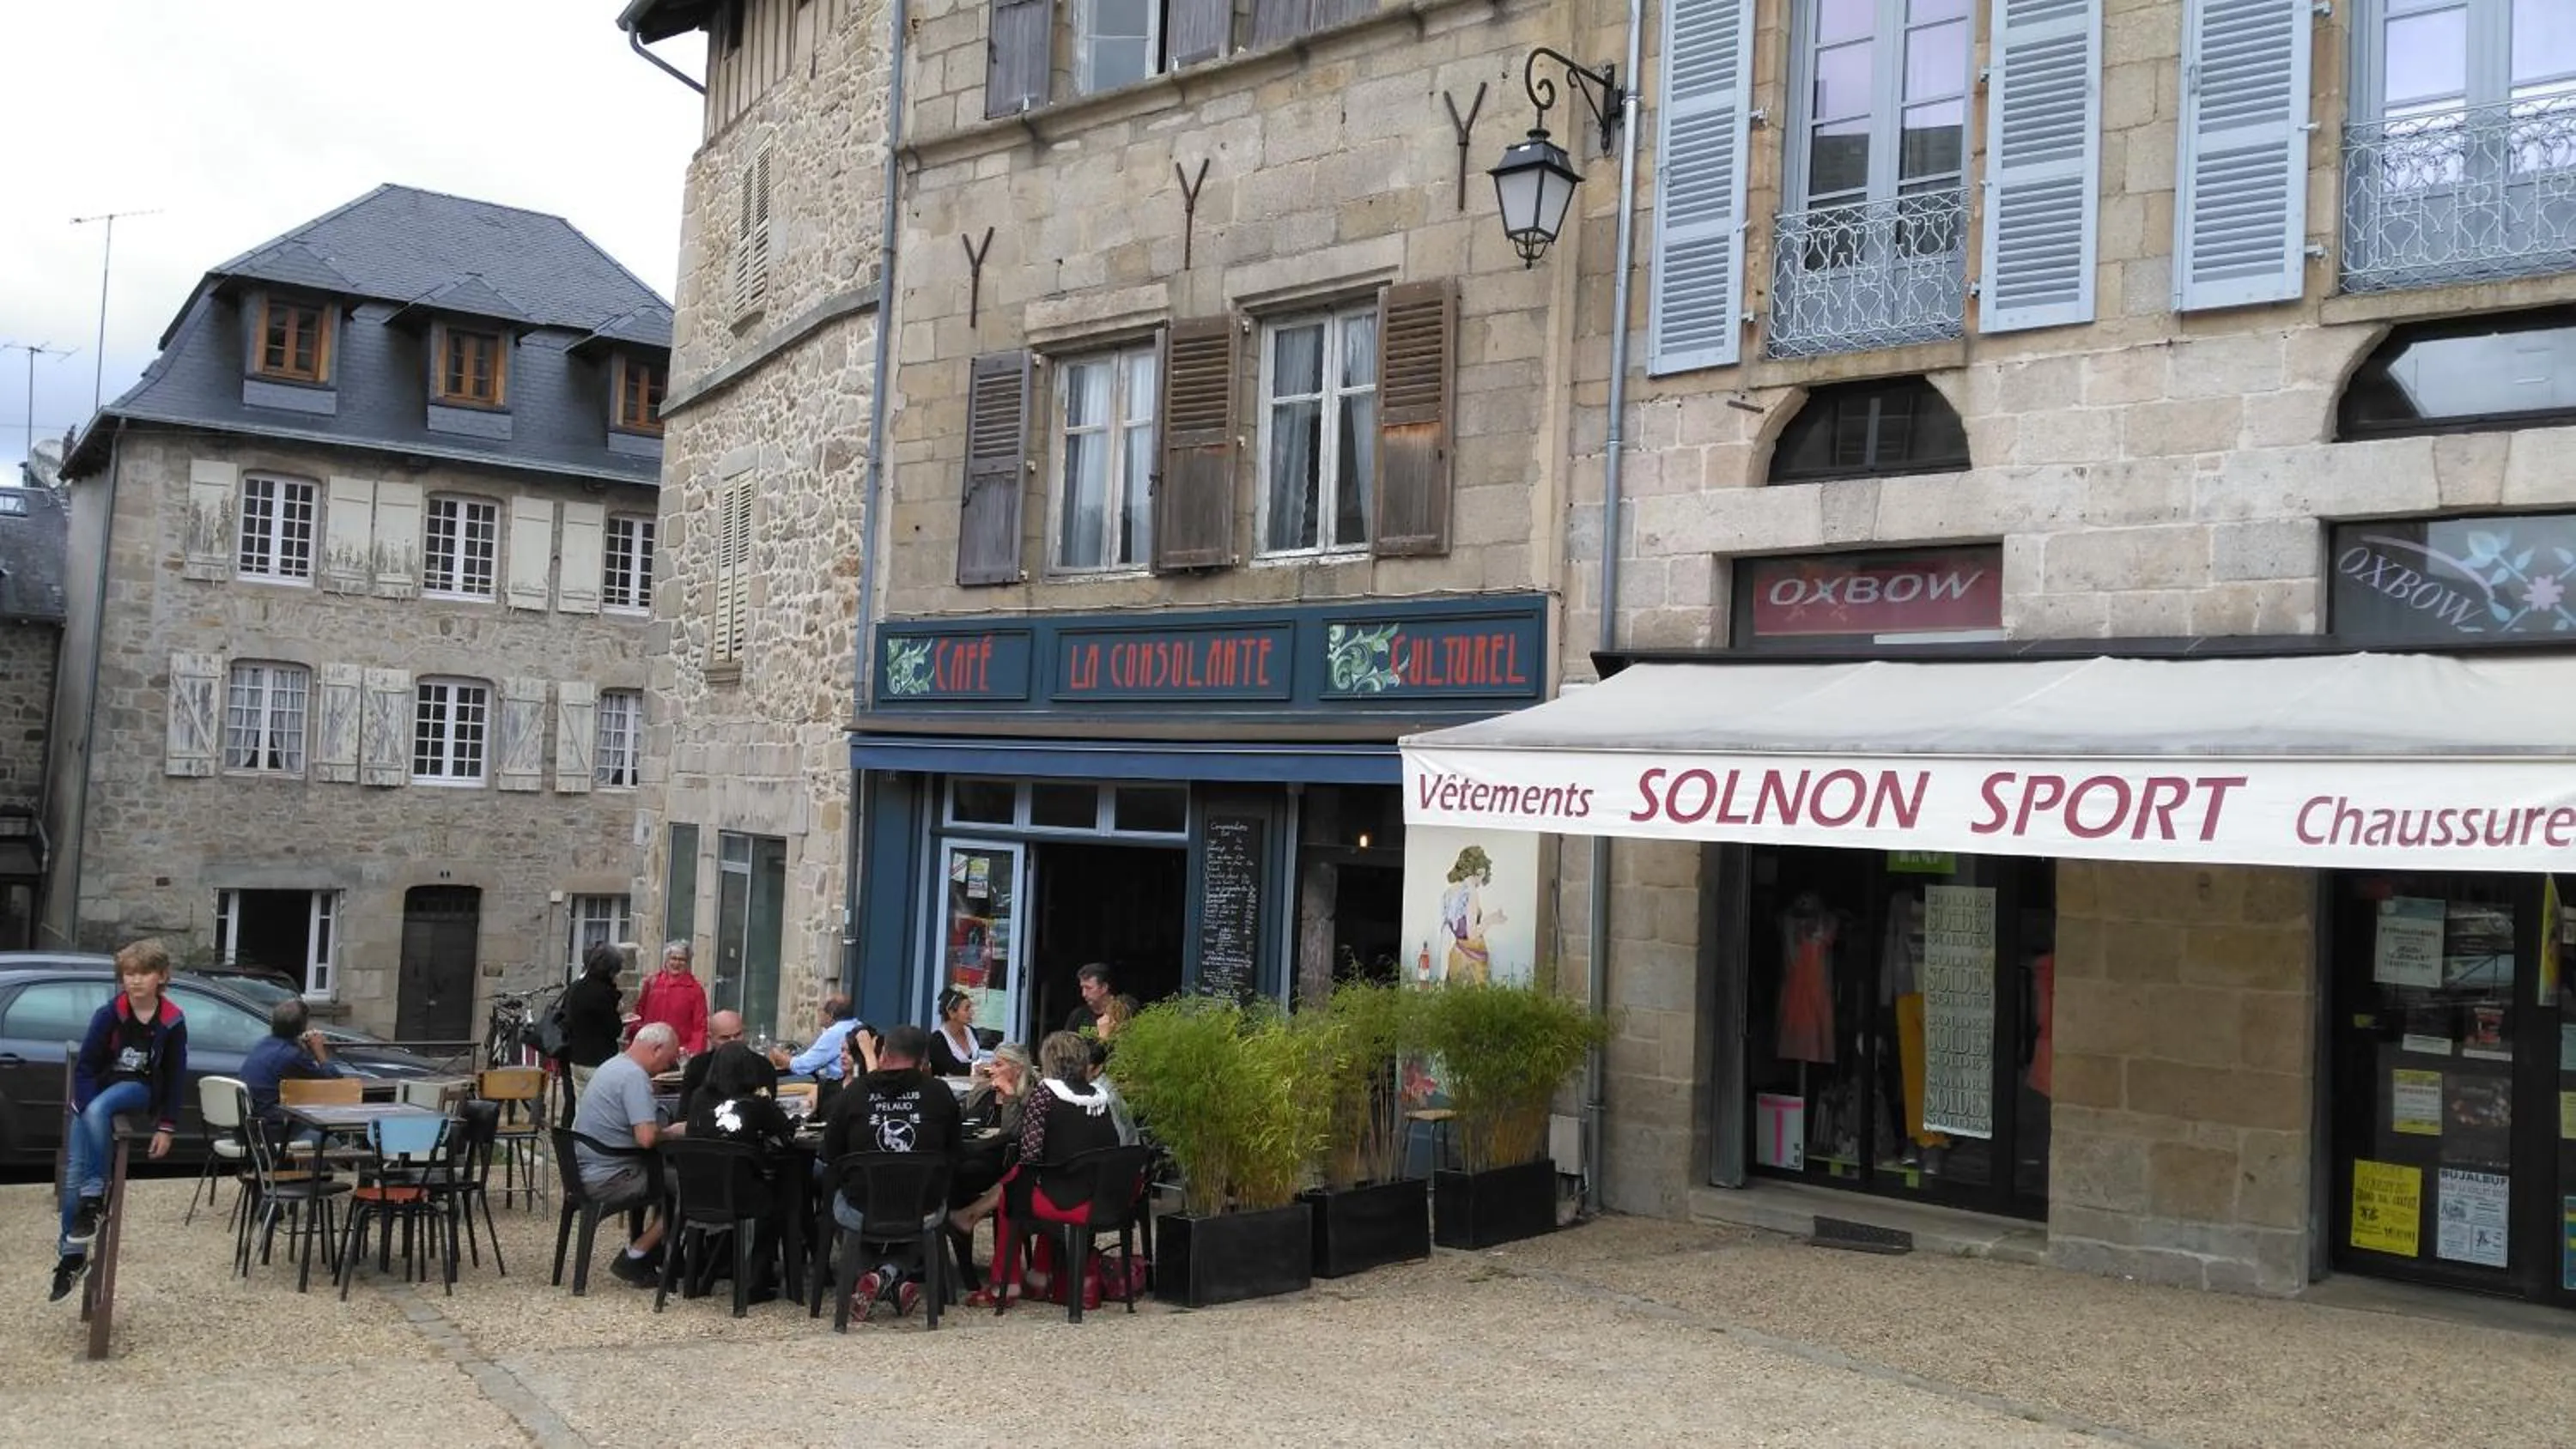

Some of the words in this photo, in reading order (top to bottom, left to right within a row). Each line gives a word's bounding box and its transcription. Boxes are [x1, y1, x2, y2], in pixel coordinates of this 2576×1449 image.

[1769, 570, 1984, 605] OXBOW
[2337, 546, 2485, 626] OXBOW
[935, 634, 993, 691] CAFÉ
[1071, 644, 1099, 689] LA
[1111, 636, 1272, 688] CONSOLANTE
[1390, 633, 1526, 686] CULTUREL
[1418, 773, 1595, 818] Vêtements
[1628, 767, 1930, 829] SOLNON
[1971, 771, 2248, 841] SPORT
[2294, 795, 2576, 848] Chaussure
